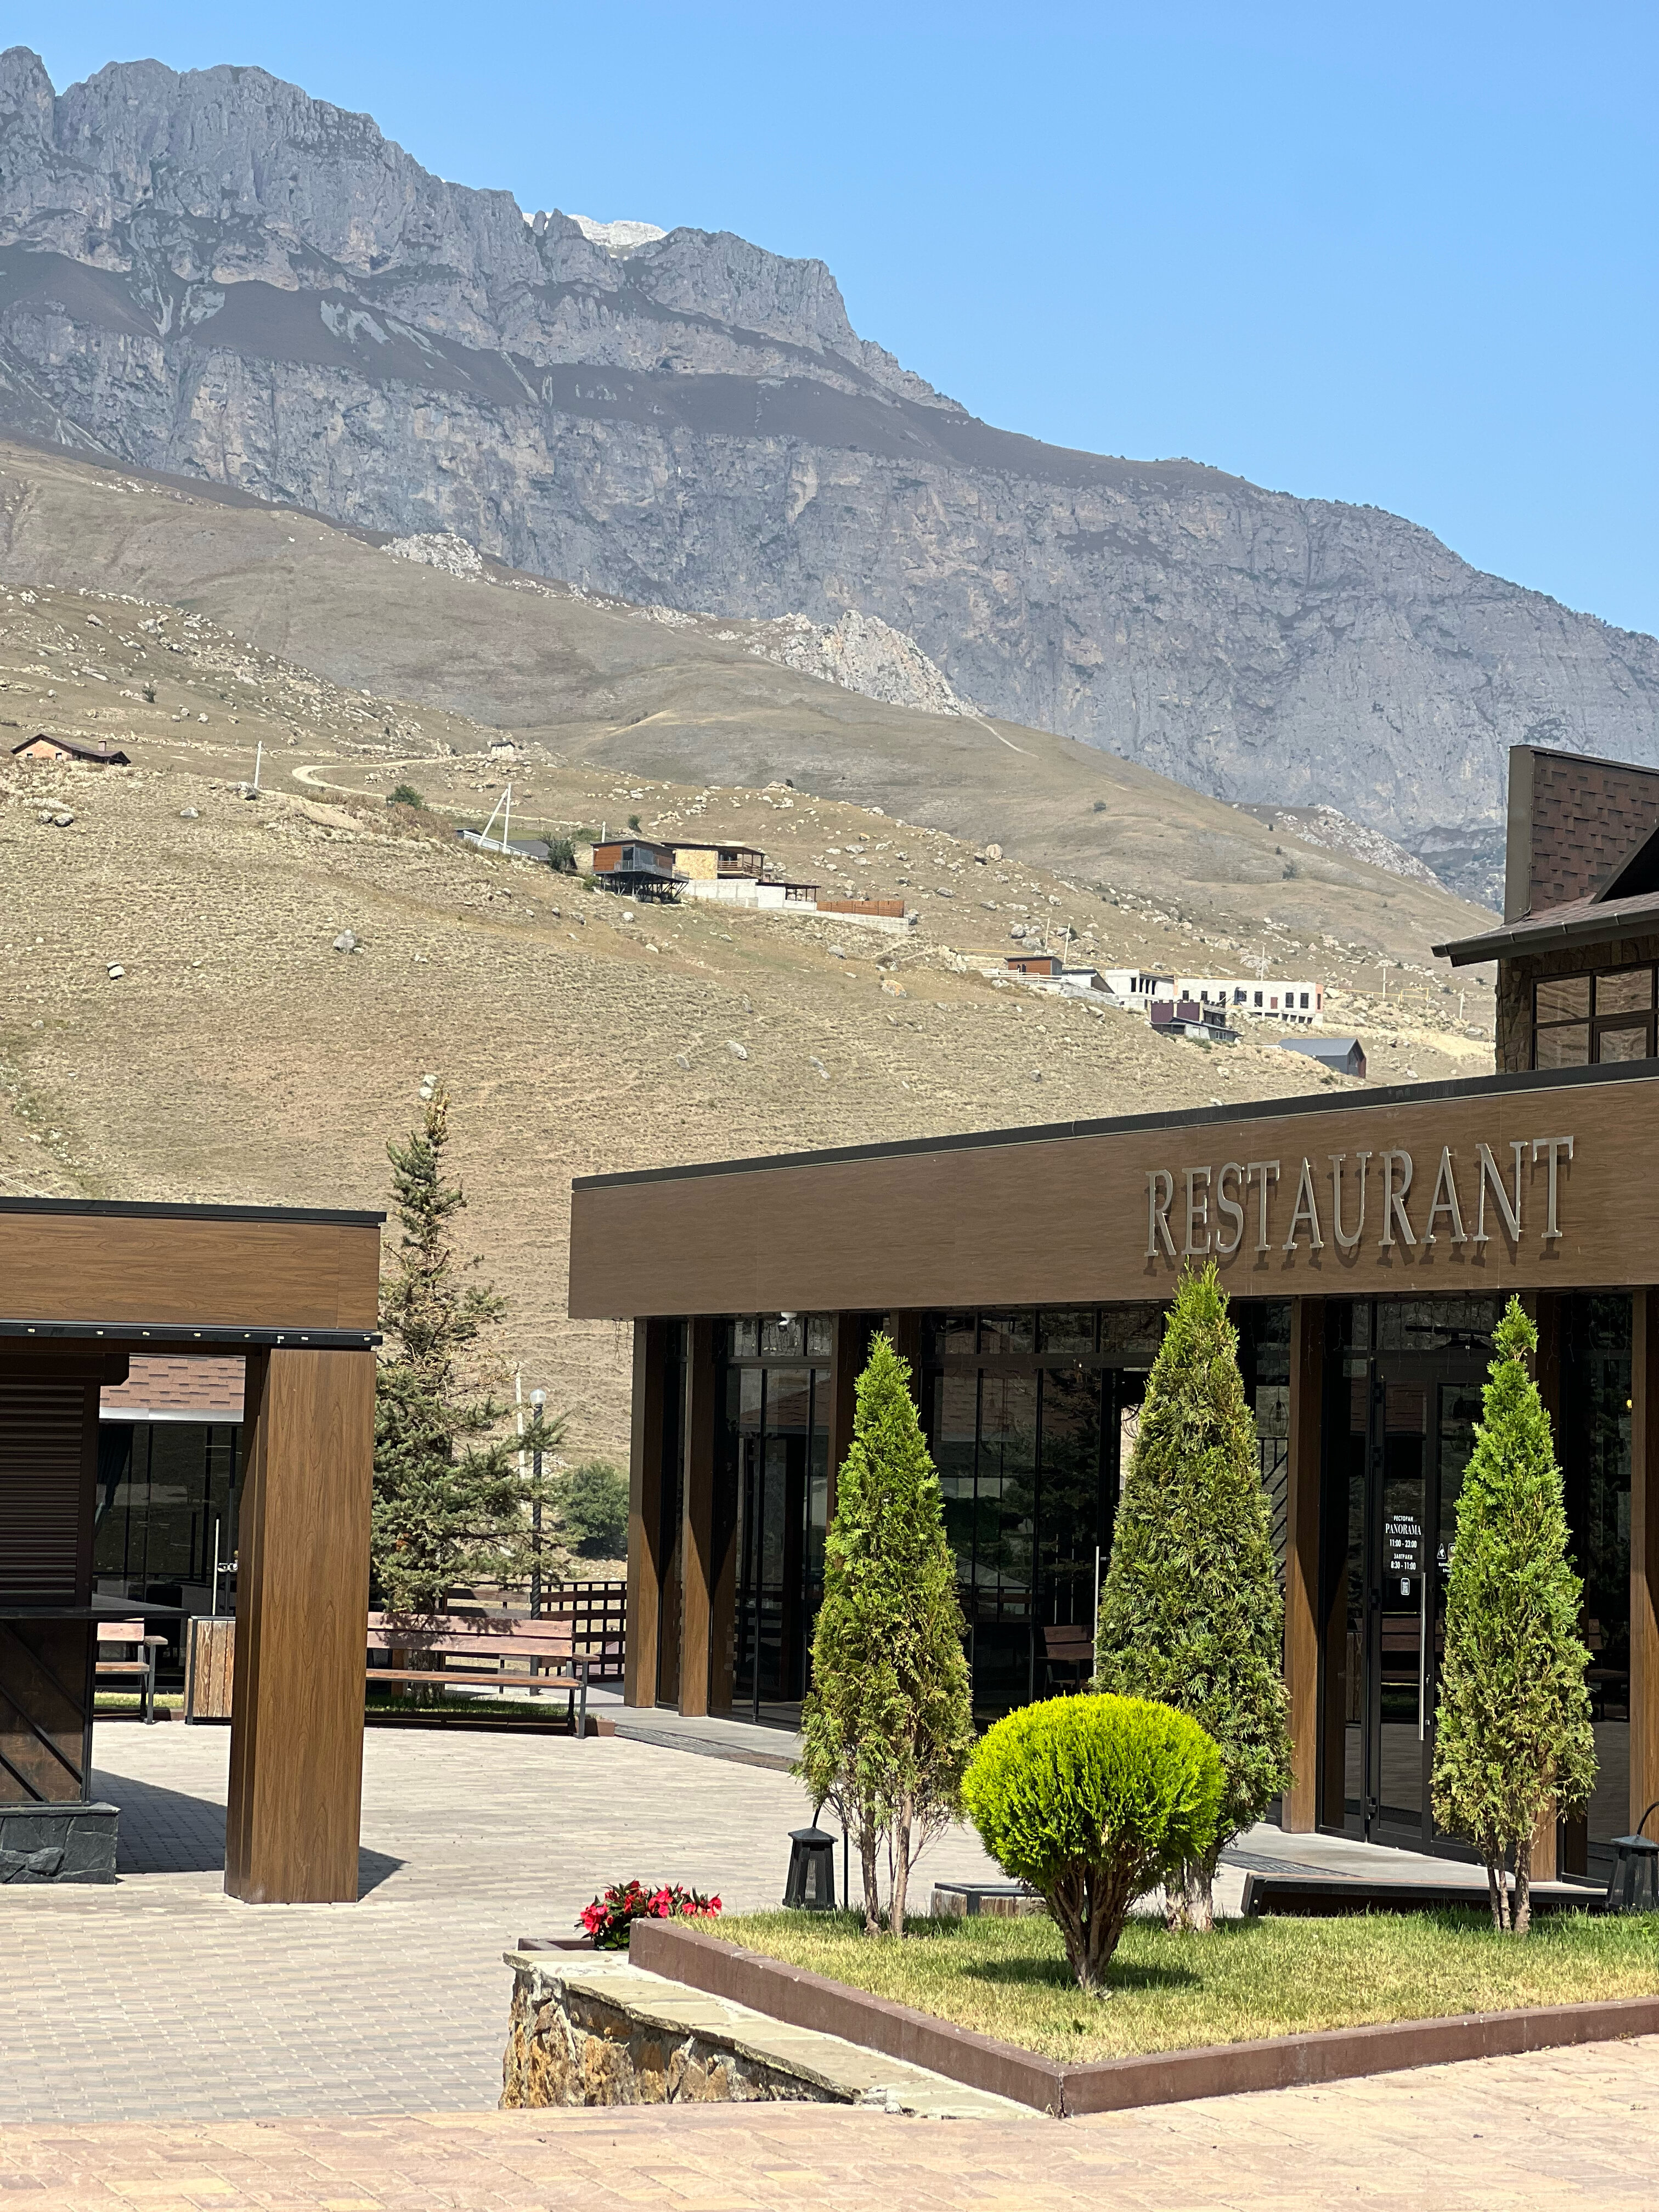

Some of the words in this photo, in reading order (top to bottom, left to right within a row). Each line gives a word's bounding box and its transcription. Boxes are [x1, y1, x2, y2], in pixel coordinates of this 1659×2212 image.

[1144, 1136, 1574, 1257] RESTAURANT
[1385, 1523, 1421, 1535] PANORAMA
[1390, 1539, 1401, 1547] 11:00
[1405, 1539, 1417, 1548] 23:00
[1391, 1561, 1400, 1569] 8:30
[1404, 1562, 1416, 1570] 11:00
